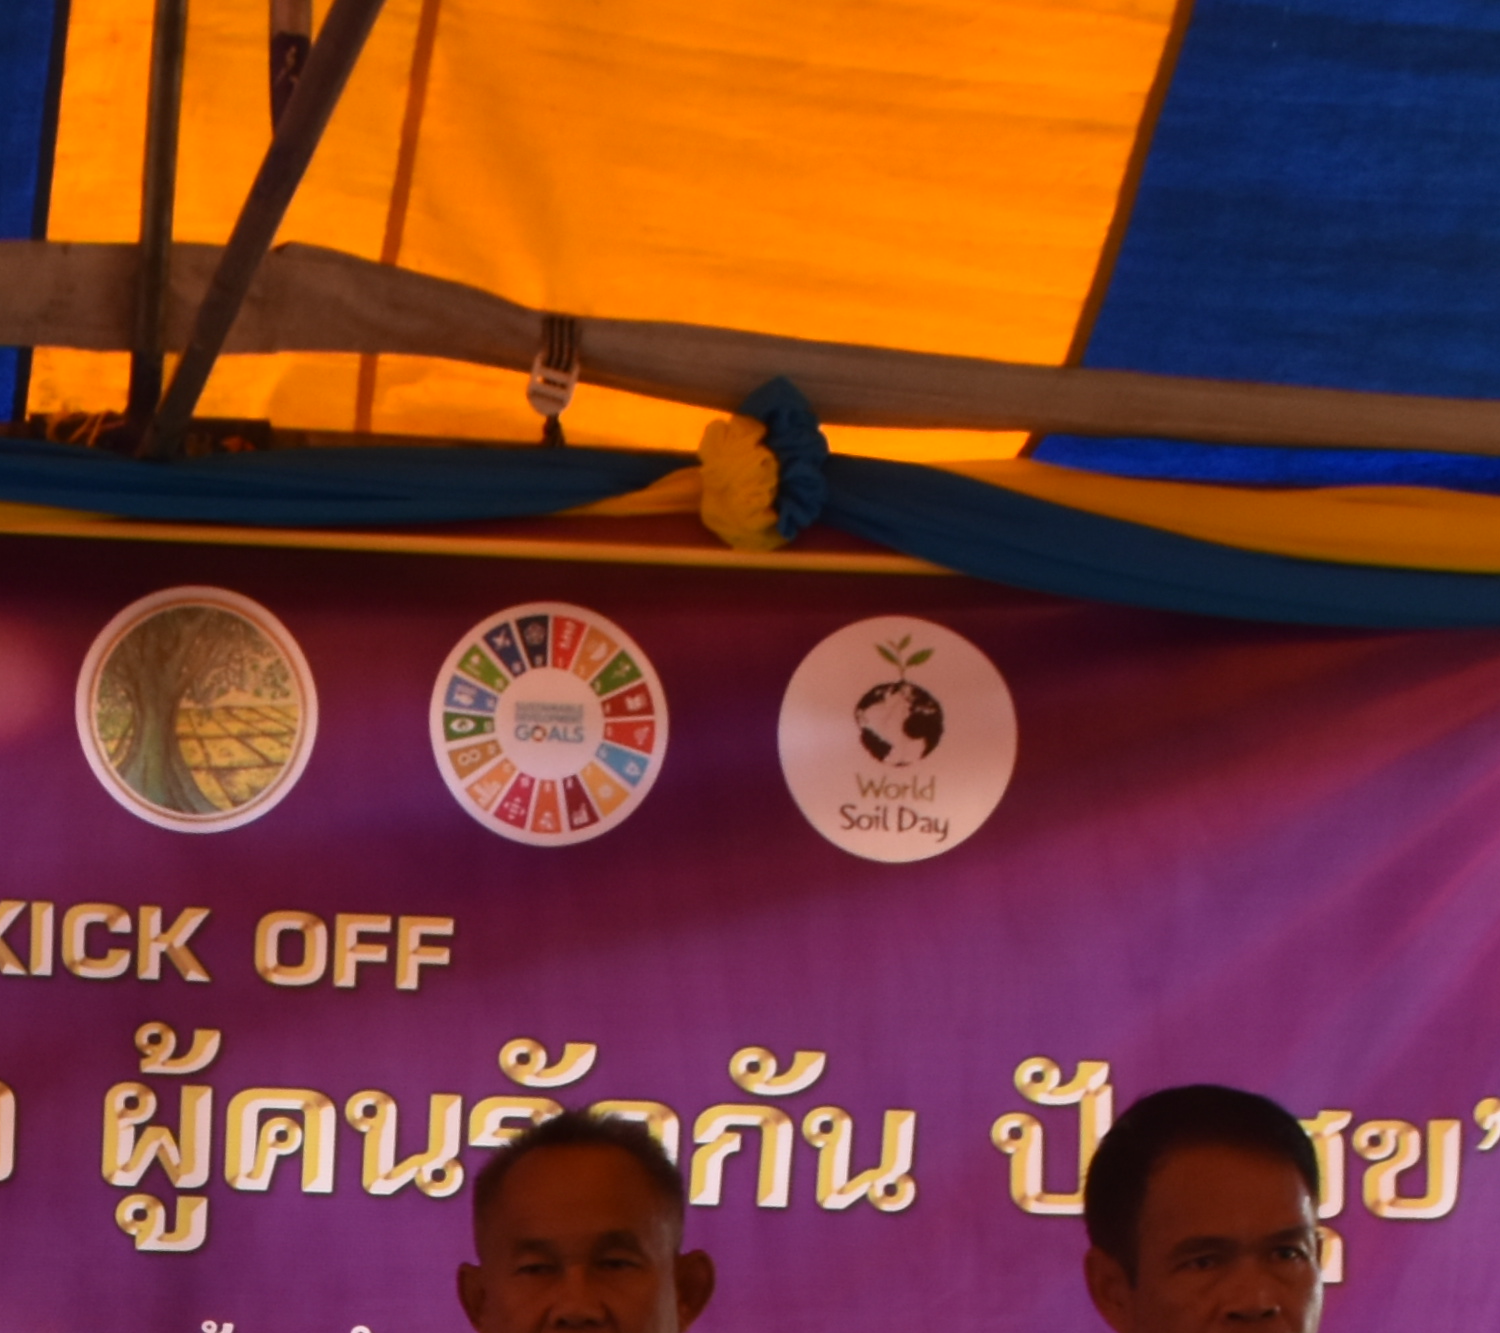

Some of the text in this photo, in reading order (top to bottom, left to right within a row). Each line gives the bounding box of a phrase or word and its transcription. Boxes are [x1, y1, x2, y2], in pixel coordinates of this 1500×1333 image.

[514, 724, 585, 743] GOALS
[854, 772, 937, 802] World
[840, 804, 949, 843] Soil Day
[253, 909, 455, 991] OFF
